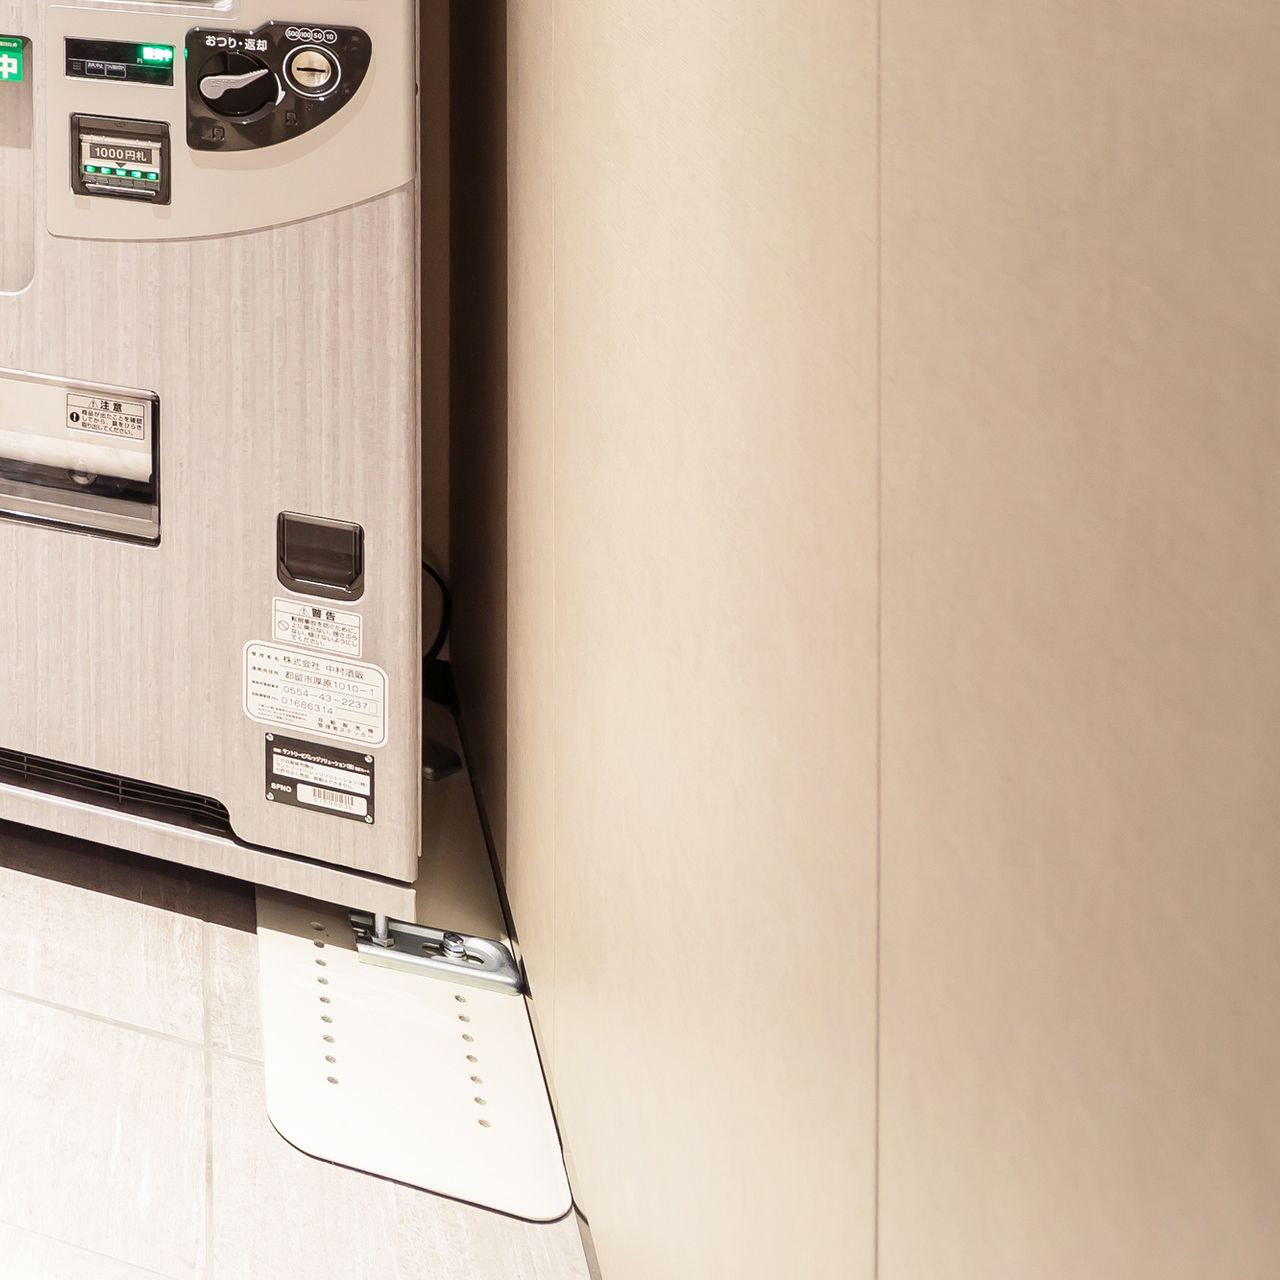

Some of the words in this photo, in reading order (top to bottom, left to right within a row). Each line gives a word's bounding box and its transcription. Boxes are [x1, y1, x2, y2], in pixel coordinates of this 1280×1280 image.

[205, 35, 268, 52] おつり・返却
[94, 146, 147, 161] 1000円札
[99, 399, 123, 413] 注意
[81, 409, 143, 425] 商品が出たことを確認
[311, 608, 336, 622] 警告
[283, 655, 321, 671] 株式会社
